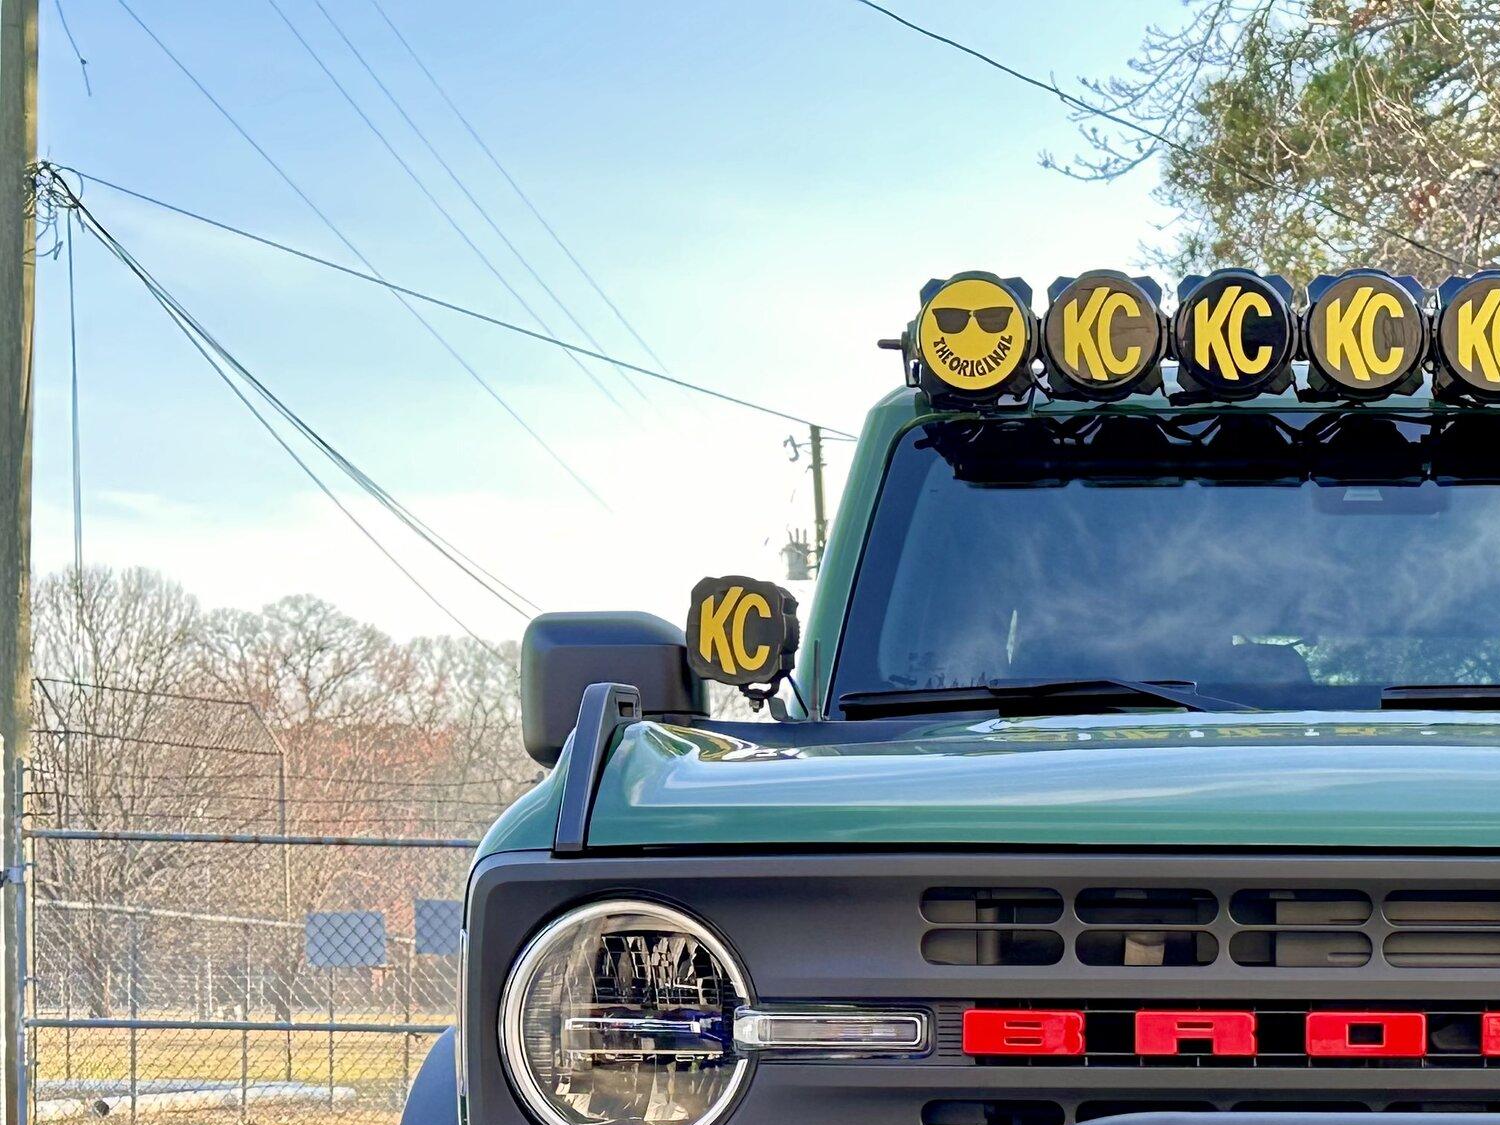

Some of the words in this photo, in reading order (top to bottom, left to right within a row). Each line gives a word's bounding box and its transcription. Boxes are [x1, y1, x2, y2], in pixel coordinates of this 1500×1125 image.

[933, 336, 954, 365] THE
[948, 335, 1013, 377] ORIGINAL
[1063, 287, 1142, 380] KC
[1194, 286, 1272, 380] KC
[1326, 287, 1405, 381] KC
[700, 586, 772, 675] KC
